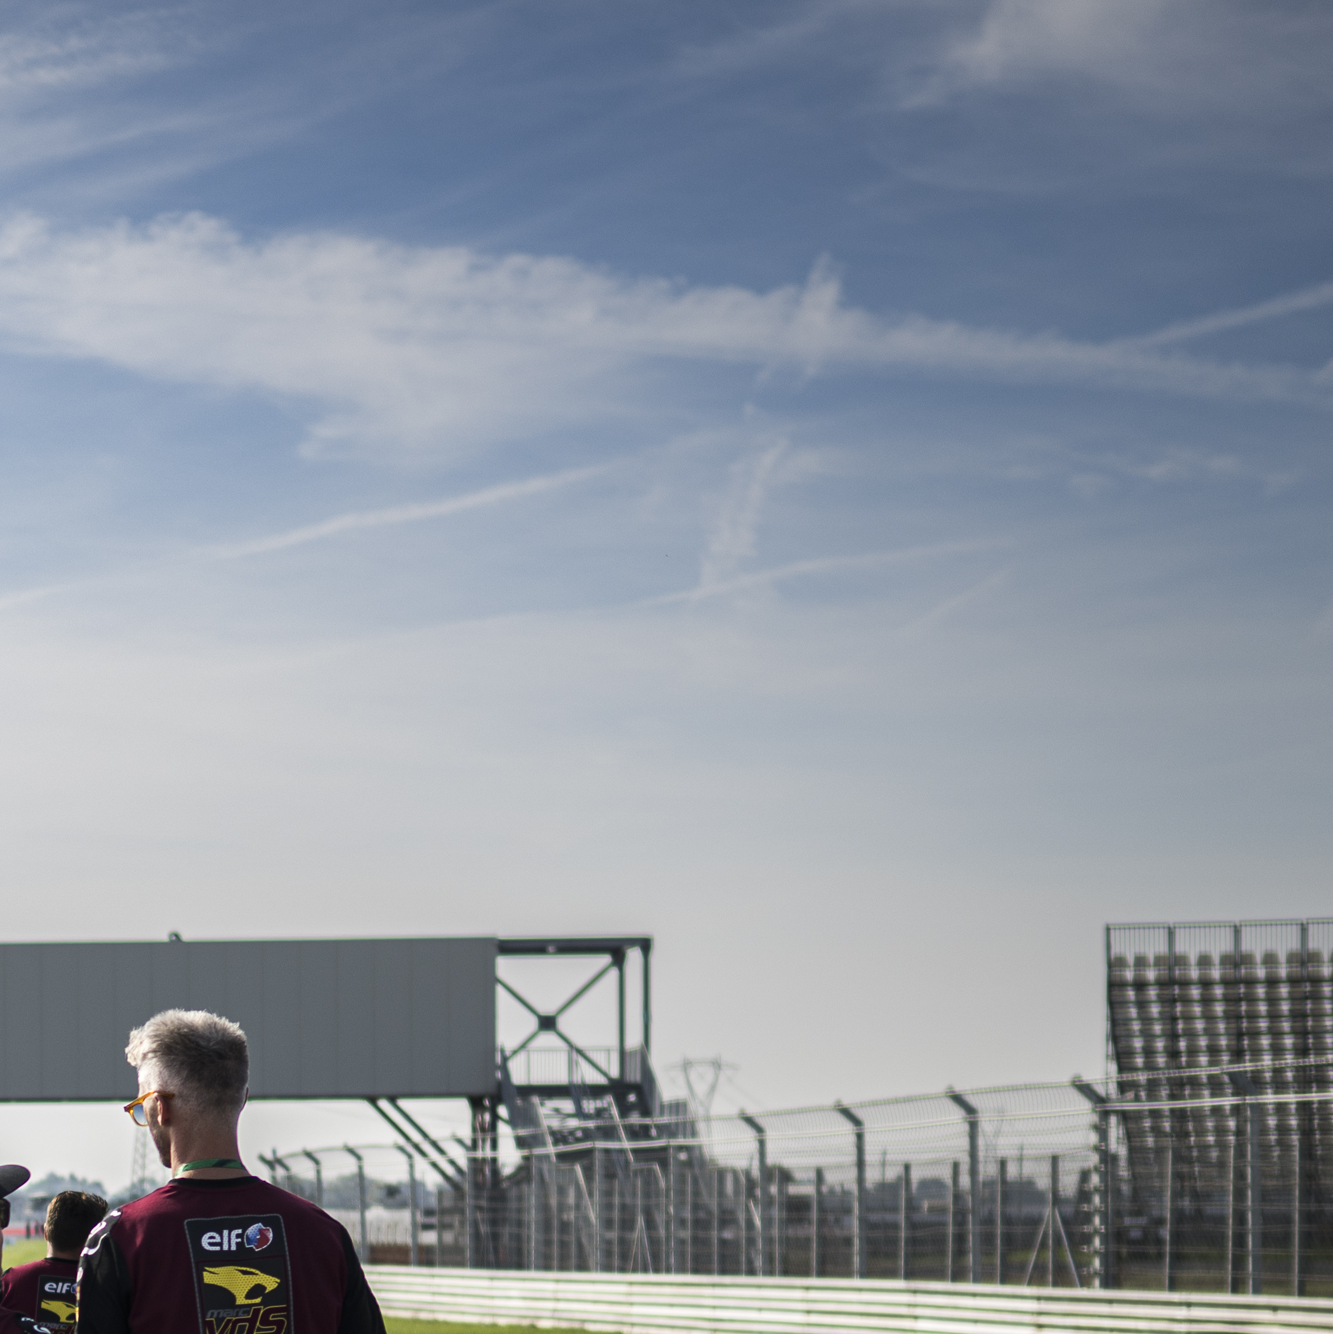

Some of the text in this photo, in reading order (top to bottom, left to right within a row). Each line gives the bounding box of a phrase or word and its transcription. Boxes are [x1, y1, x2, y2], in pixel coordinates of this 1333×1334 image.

[201, 1229, 242, 1251] elf
[44, 1282, 71, 1294] elf
[206, 1307, 251, 1318] marc
